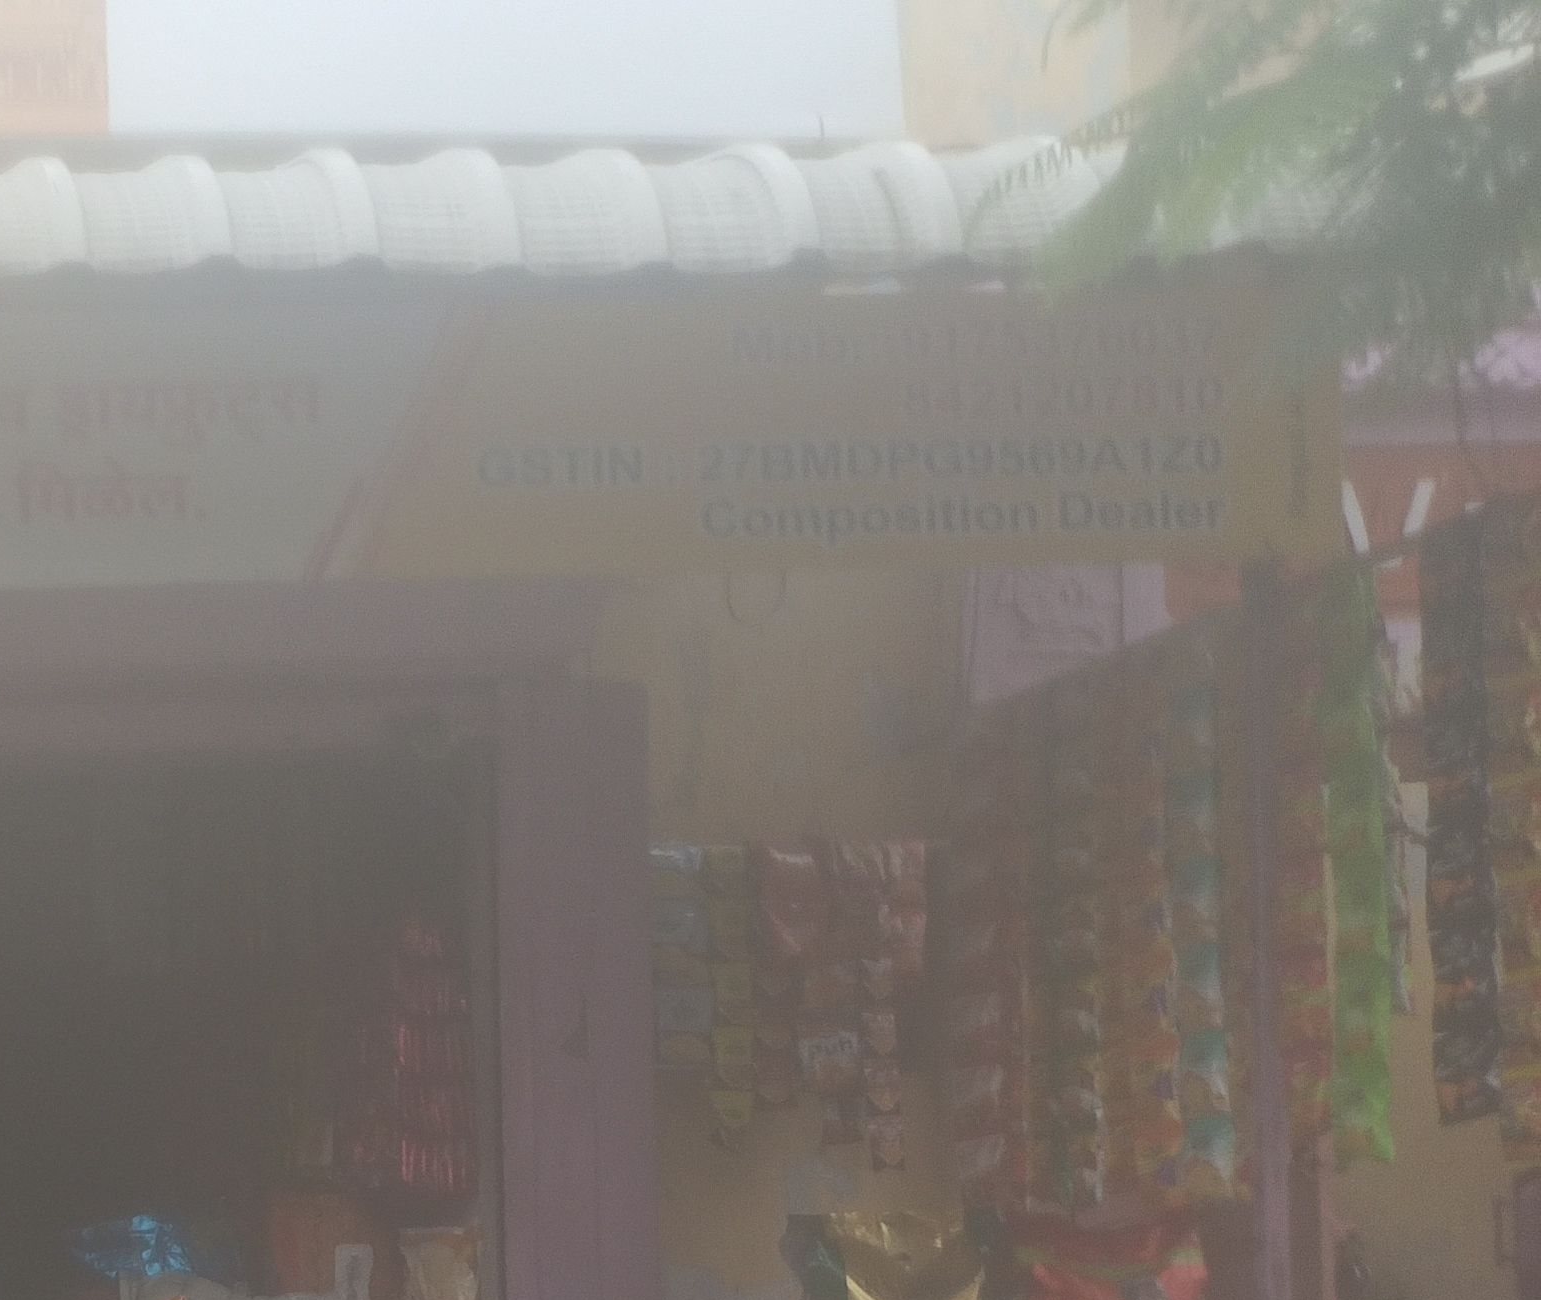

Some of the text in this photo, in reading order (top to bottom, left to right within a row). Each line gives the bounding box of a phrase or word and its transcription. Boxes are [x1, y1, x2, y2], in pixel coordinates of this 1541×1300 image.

[477, 447, 643, 488] GSTIN
[700, 491, 1224, 544] Composition Dealer
